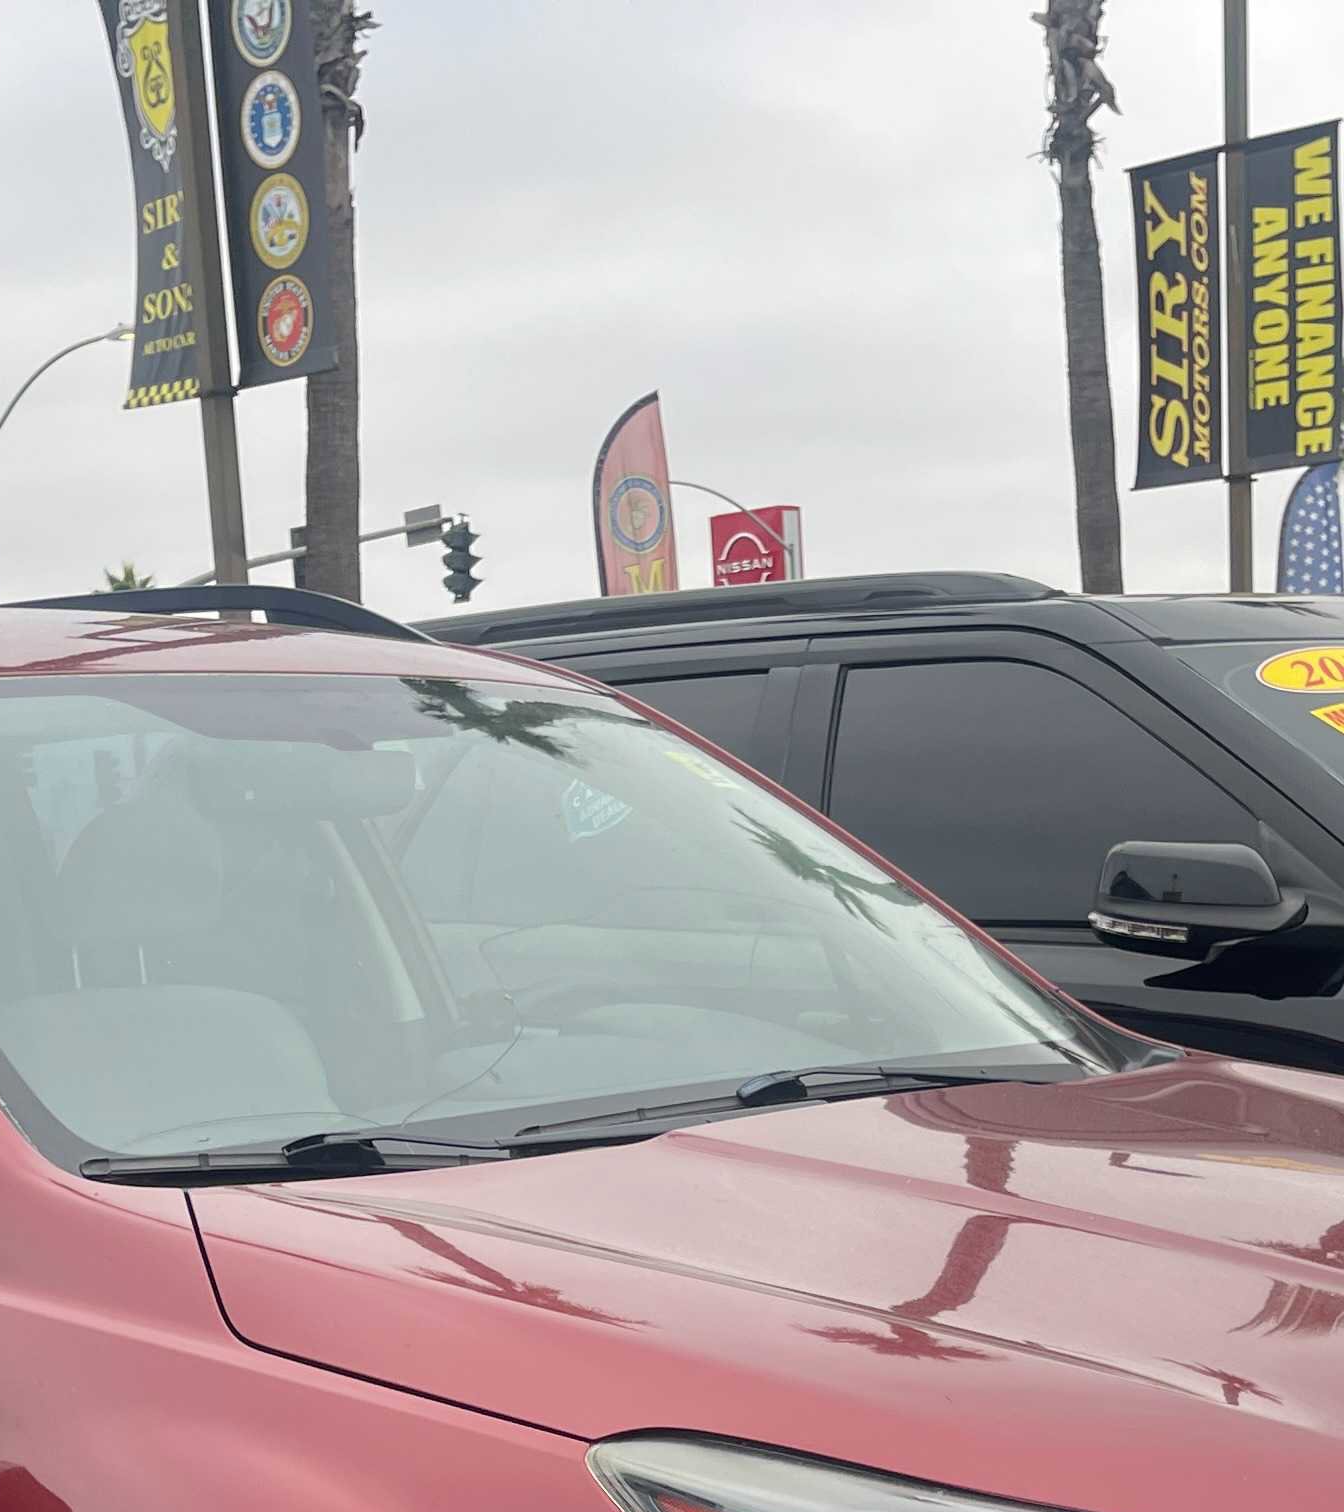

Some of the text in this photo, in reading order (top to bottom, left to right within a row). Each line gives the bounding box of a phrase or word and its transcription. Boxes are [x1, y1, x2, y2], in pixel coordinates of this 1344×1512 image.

[142, 191, 185, 235] SIR
[161, 242, 180, 270] &
[142, 282, 193, 325] SON
[1143, 179, 1191, 469] SIRY
[1188, 171, 1211, 464] MOTORS.COM
[1251, 207, 1289, 412] ANYONE
[1293, 136, 1336, 458] WE FINANCE
[716, 557, 774, 576] NISSAN
